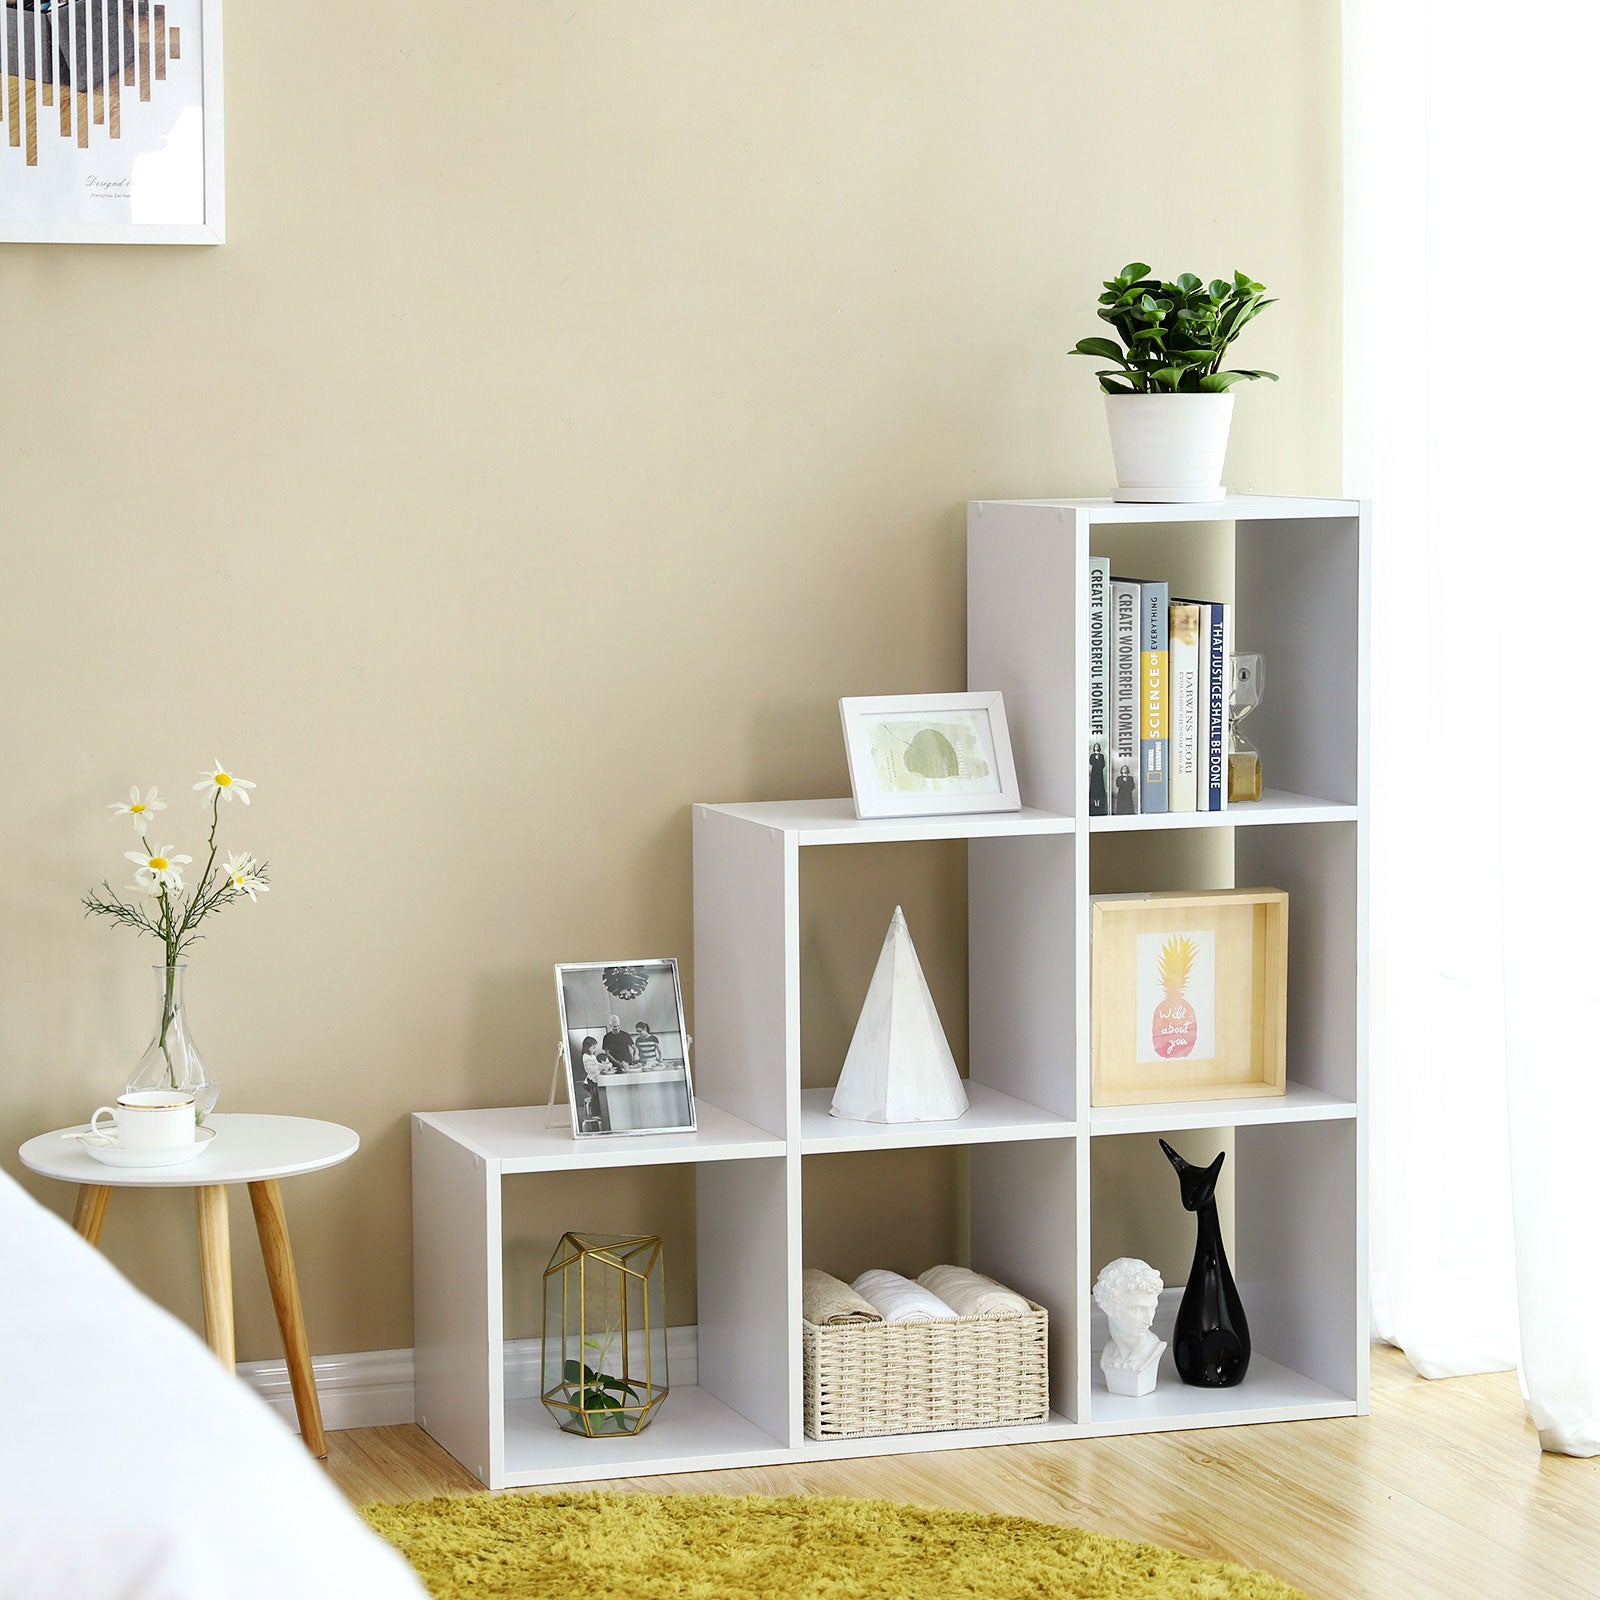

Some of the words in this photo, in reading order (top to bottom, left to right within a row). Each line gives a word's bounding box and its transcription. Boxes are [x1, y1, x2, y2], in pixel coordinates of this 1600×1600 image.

[1091, 569, 1103, 608] CREATE
[1118, 593, 1132, 632] CREATE
[1150, 596, 1158, 650] EVERYTHING
[1091, 611, 1103, 679] WONDERFUL
[1212, 622, 1223, 652] THAT
[1118, 635, 1132, 702] WONDERFUL
[1150, 652, 1160, 666] OF
[1212, 654, 1222, 702] JUSTICE
[1091, 682, 1103, 736] HOMELIFE
[1149, 668, 1160, 738] SCIENCE
[1185, 671, 1194, 732] DARWINS
[1211, 703, 1222, 738] SHALL
[1118, 705, 1132, 758] HOMELIFE
[1210, 740, 1221, 754] BE
[1185, 736, 1194, 775] TEORI
[1210, 756, 1221, 789] DONE
[1161, 1021, 1192, 1035] about
[1166, 1038, 1189, 1055] you
